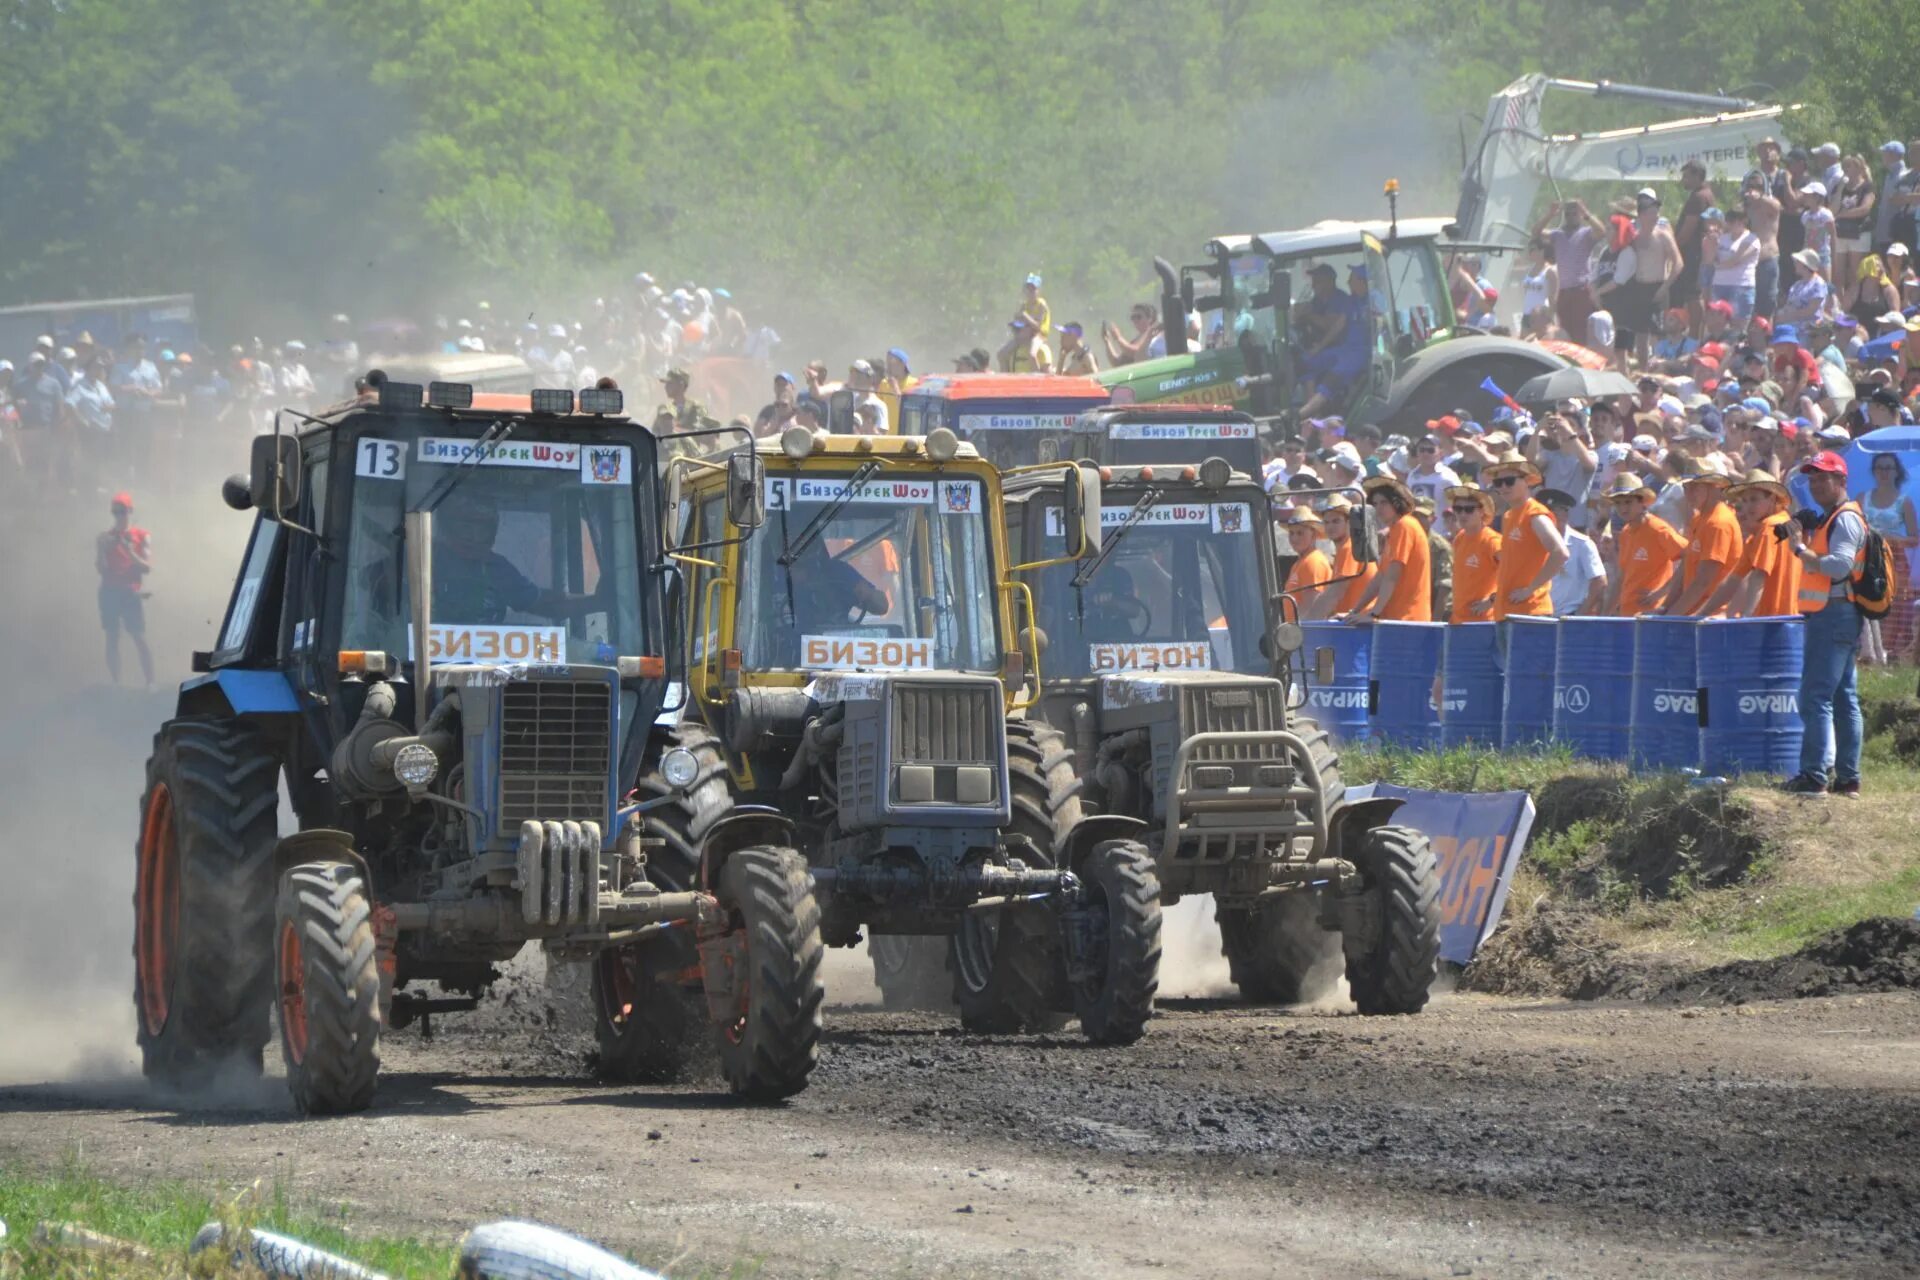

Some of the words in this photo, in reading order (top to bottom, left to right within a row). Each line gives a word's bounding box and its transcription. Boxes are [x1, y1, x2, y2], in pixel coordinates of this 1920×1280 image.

[1701, 145, 1746, 163] TERE
[990, 416, 1076, 427] БизонТрекШ
[364, 442, 400, 475] 13
[429, 629, 559, 661] БИЗОН
[807, 639, 928, 667] БИЗОН
[1096, 645, 1205, 670] БИЗОН
[1653, 694, 1699, 714] RAG
[1738, 695, 1799, 714] VIRAG
